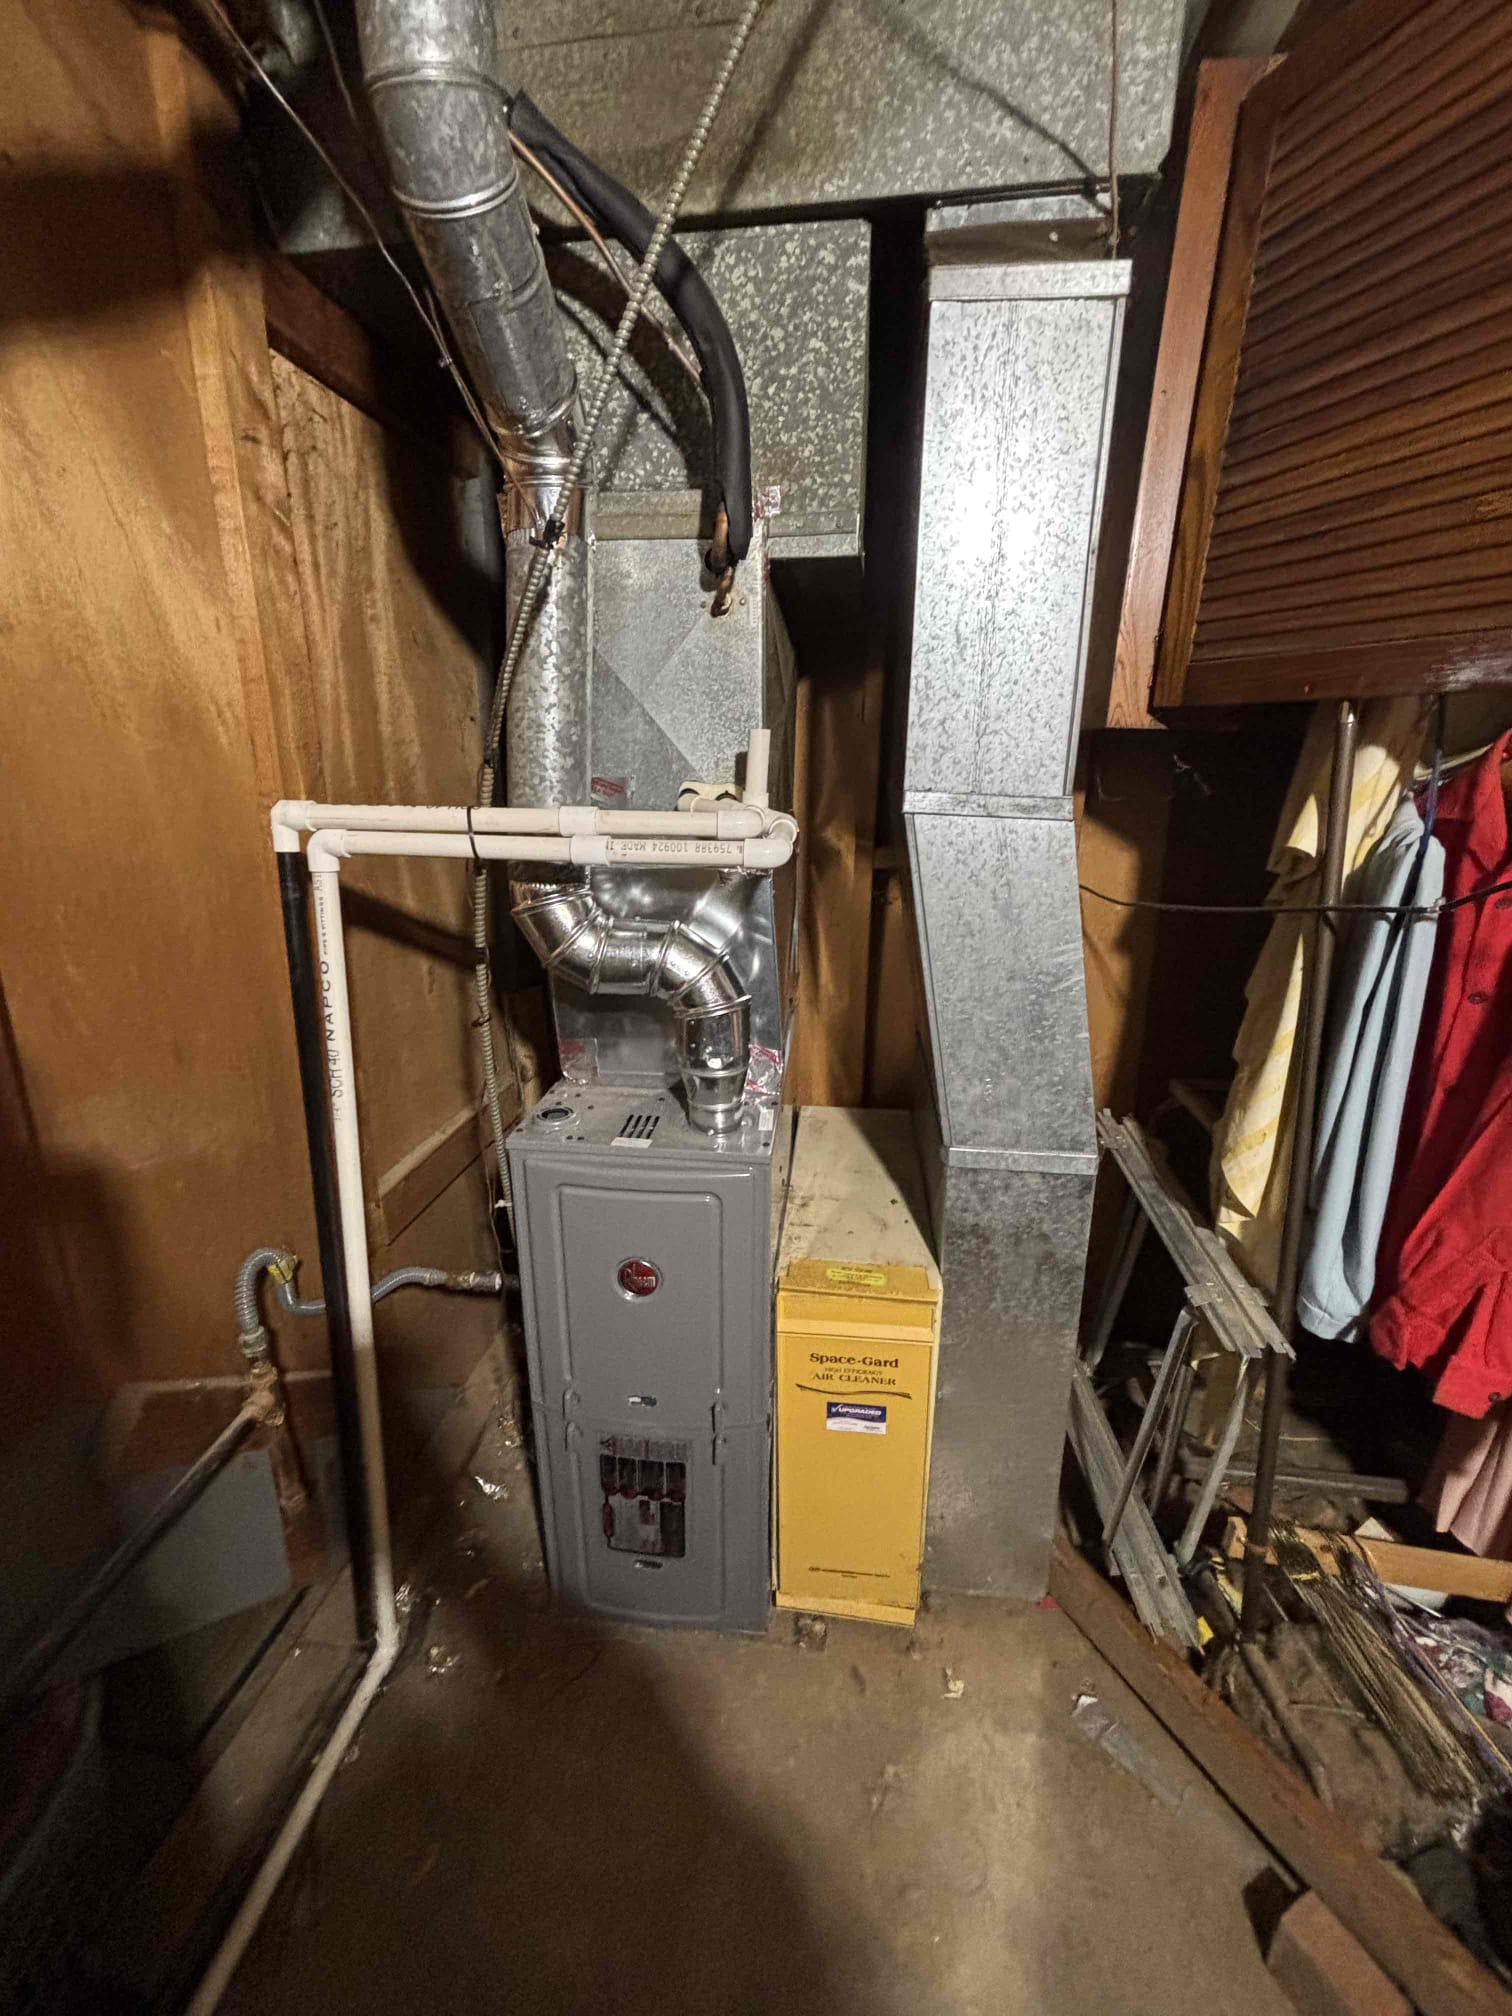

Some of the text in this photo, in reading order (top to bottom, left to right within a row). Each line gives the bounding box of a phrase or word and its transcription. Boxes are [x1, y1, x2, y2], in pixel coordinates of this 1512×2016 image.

[621, 841, 647, 852] MADE
[652, 841, 688, 853] 100924
[320, 961, 336, 1041] NAPCO
[327, 1050, 341, 1067] 40
[329, 1068, 344, 1098] SCH
[808, 1352, 899, 1368] Space-Gard
[813, 1373, 897, 1386] AIR CLEANER
